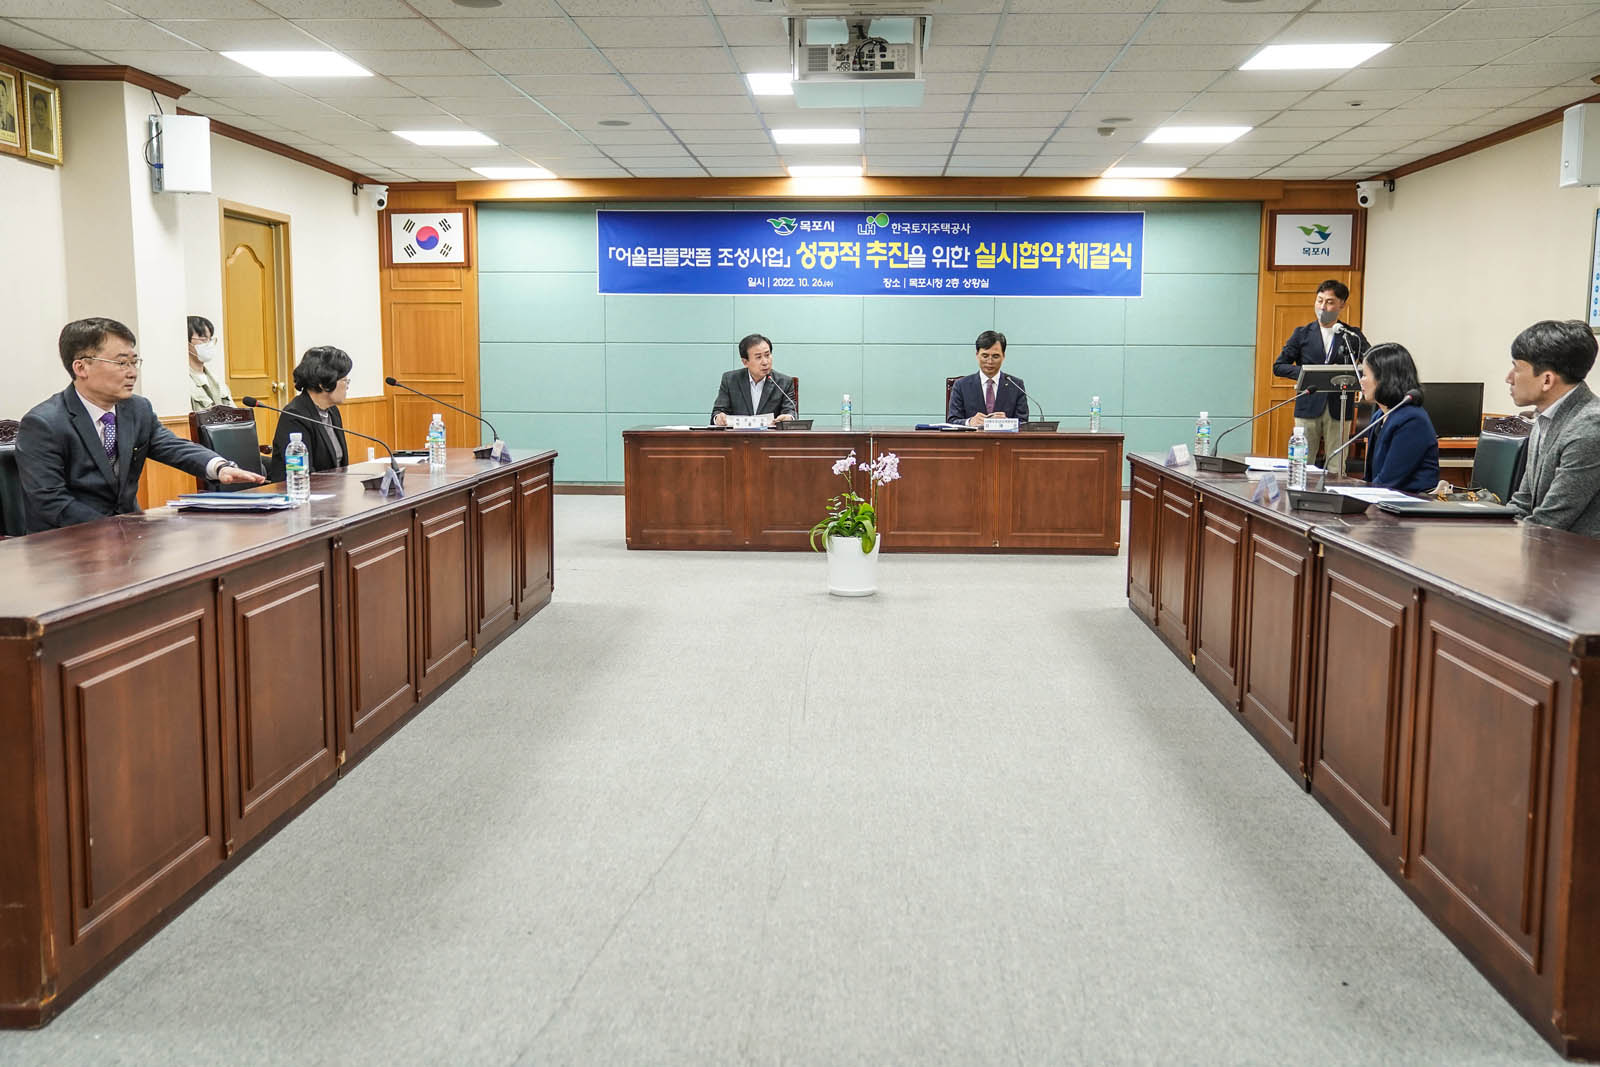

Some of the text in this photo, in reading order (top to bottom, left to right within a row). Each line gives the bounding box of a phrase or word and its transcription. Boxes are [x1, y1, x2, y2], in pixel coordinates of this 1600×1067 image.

[799, 220, 835, 233] 목포시
[891, 222, 972, 235] 한국토지주택공사
[608, 240, 1132, 270] 「어울림플랫폼 조성사업」 성공적 추진을 위한 실시협약 체결식
[1302, 247, 1330, 257] 목포시
[747, 276, 765, 288] 일시
[772, 277, 796, 288] 2022.
[798, 277, 810, 288] 10.
[882, 277, 990, 289] 장소 목포시청 2층 상황실
